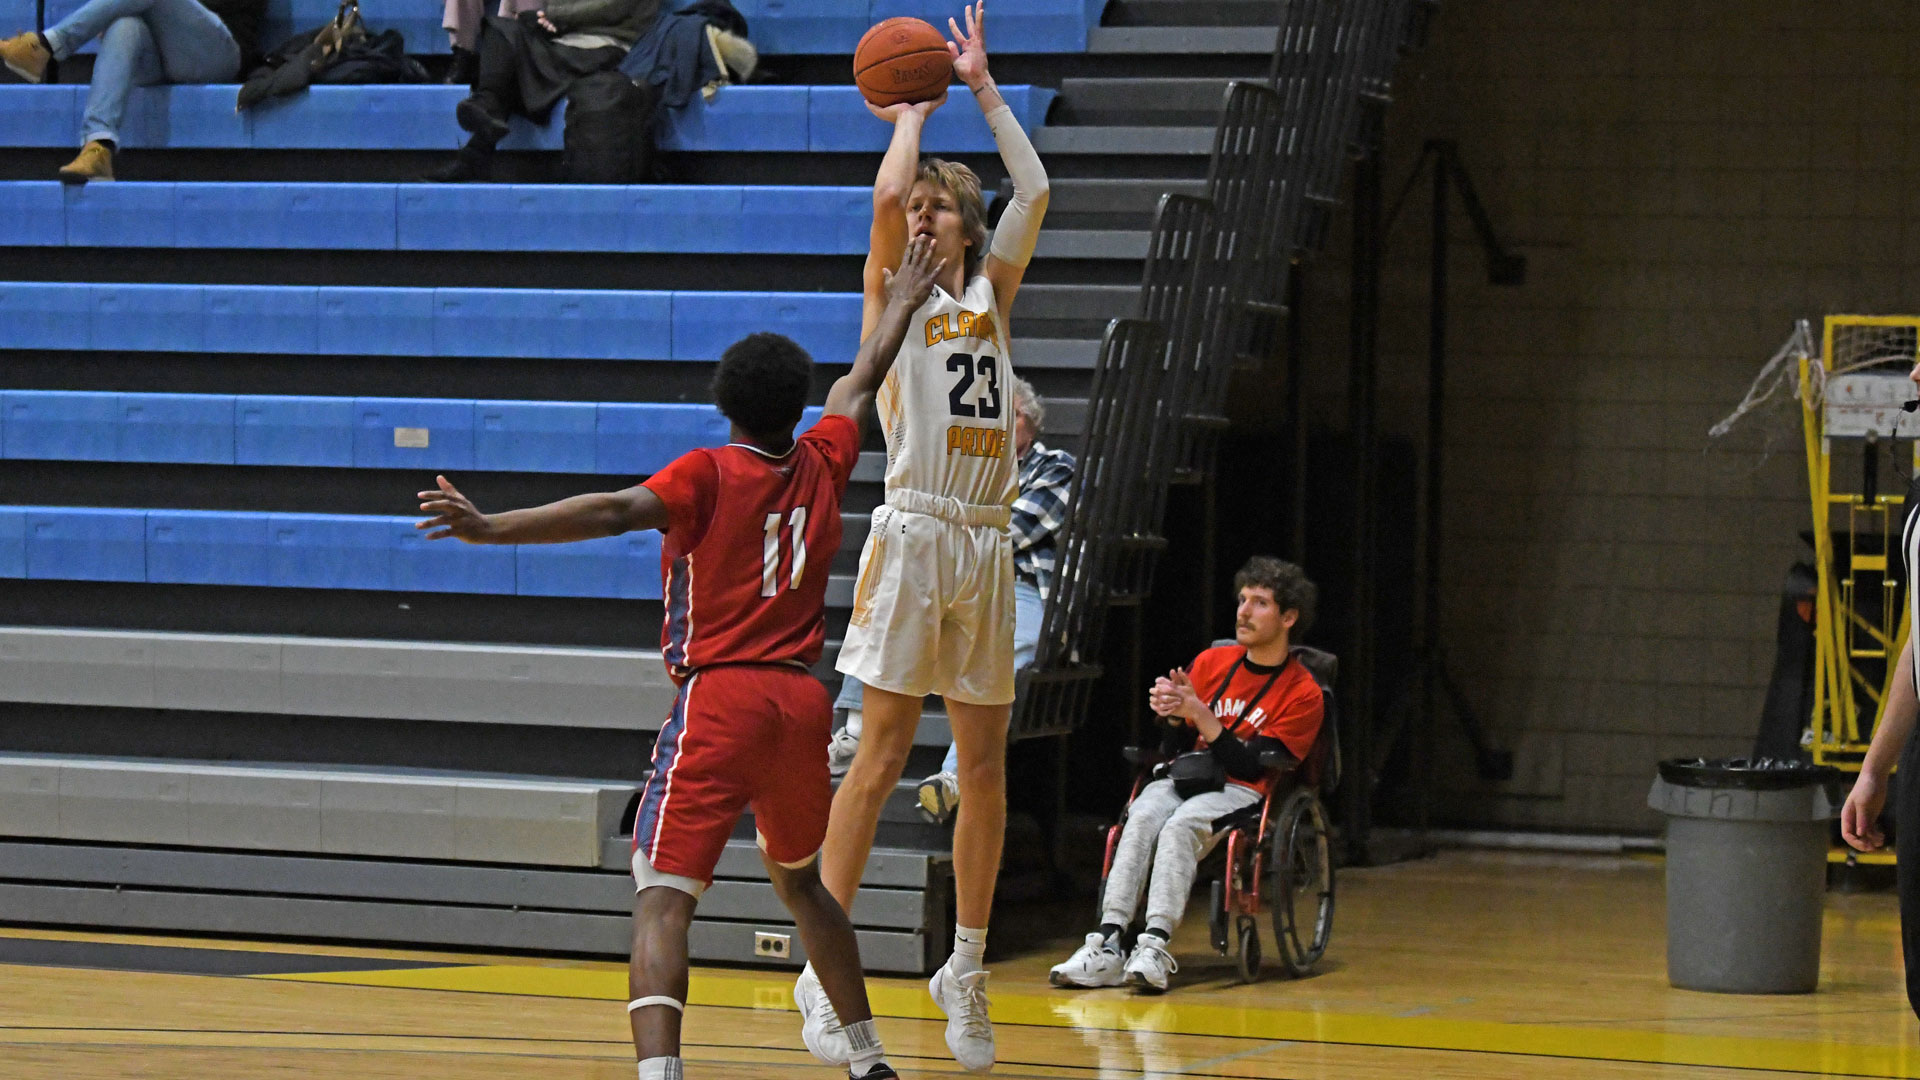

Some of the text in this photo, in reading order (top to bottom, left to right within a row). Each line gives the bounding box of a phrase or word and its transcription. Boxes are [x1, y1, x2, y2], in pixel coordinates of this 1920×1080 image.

[946, 353, 1001, 419] 23
[947, 425, 1007, 458] PRIDE
[761, 506, 806, 597] 11
